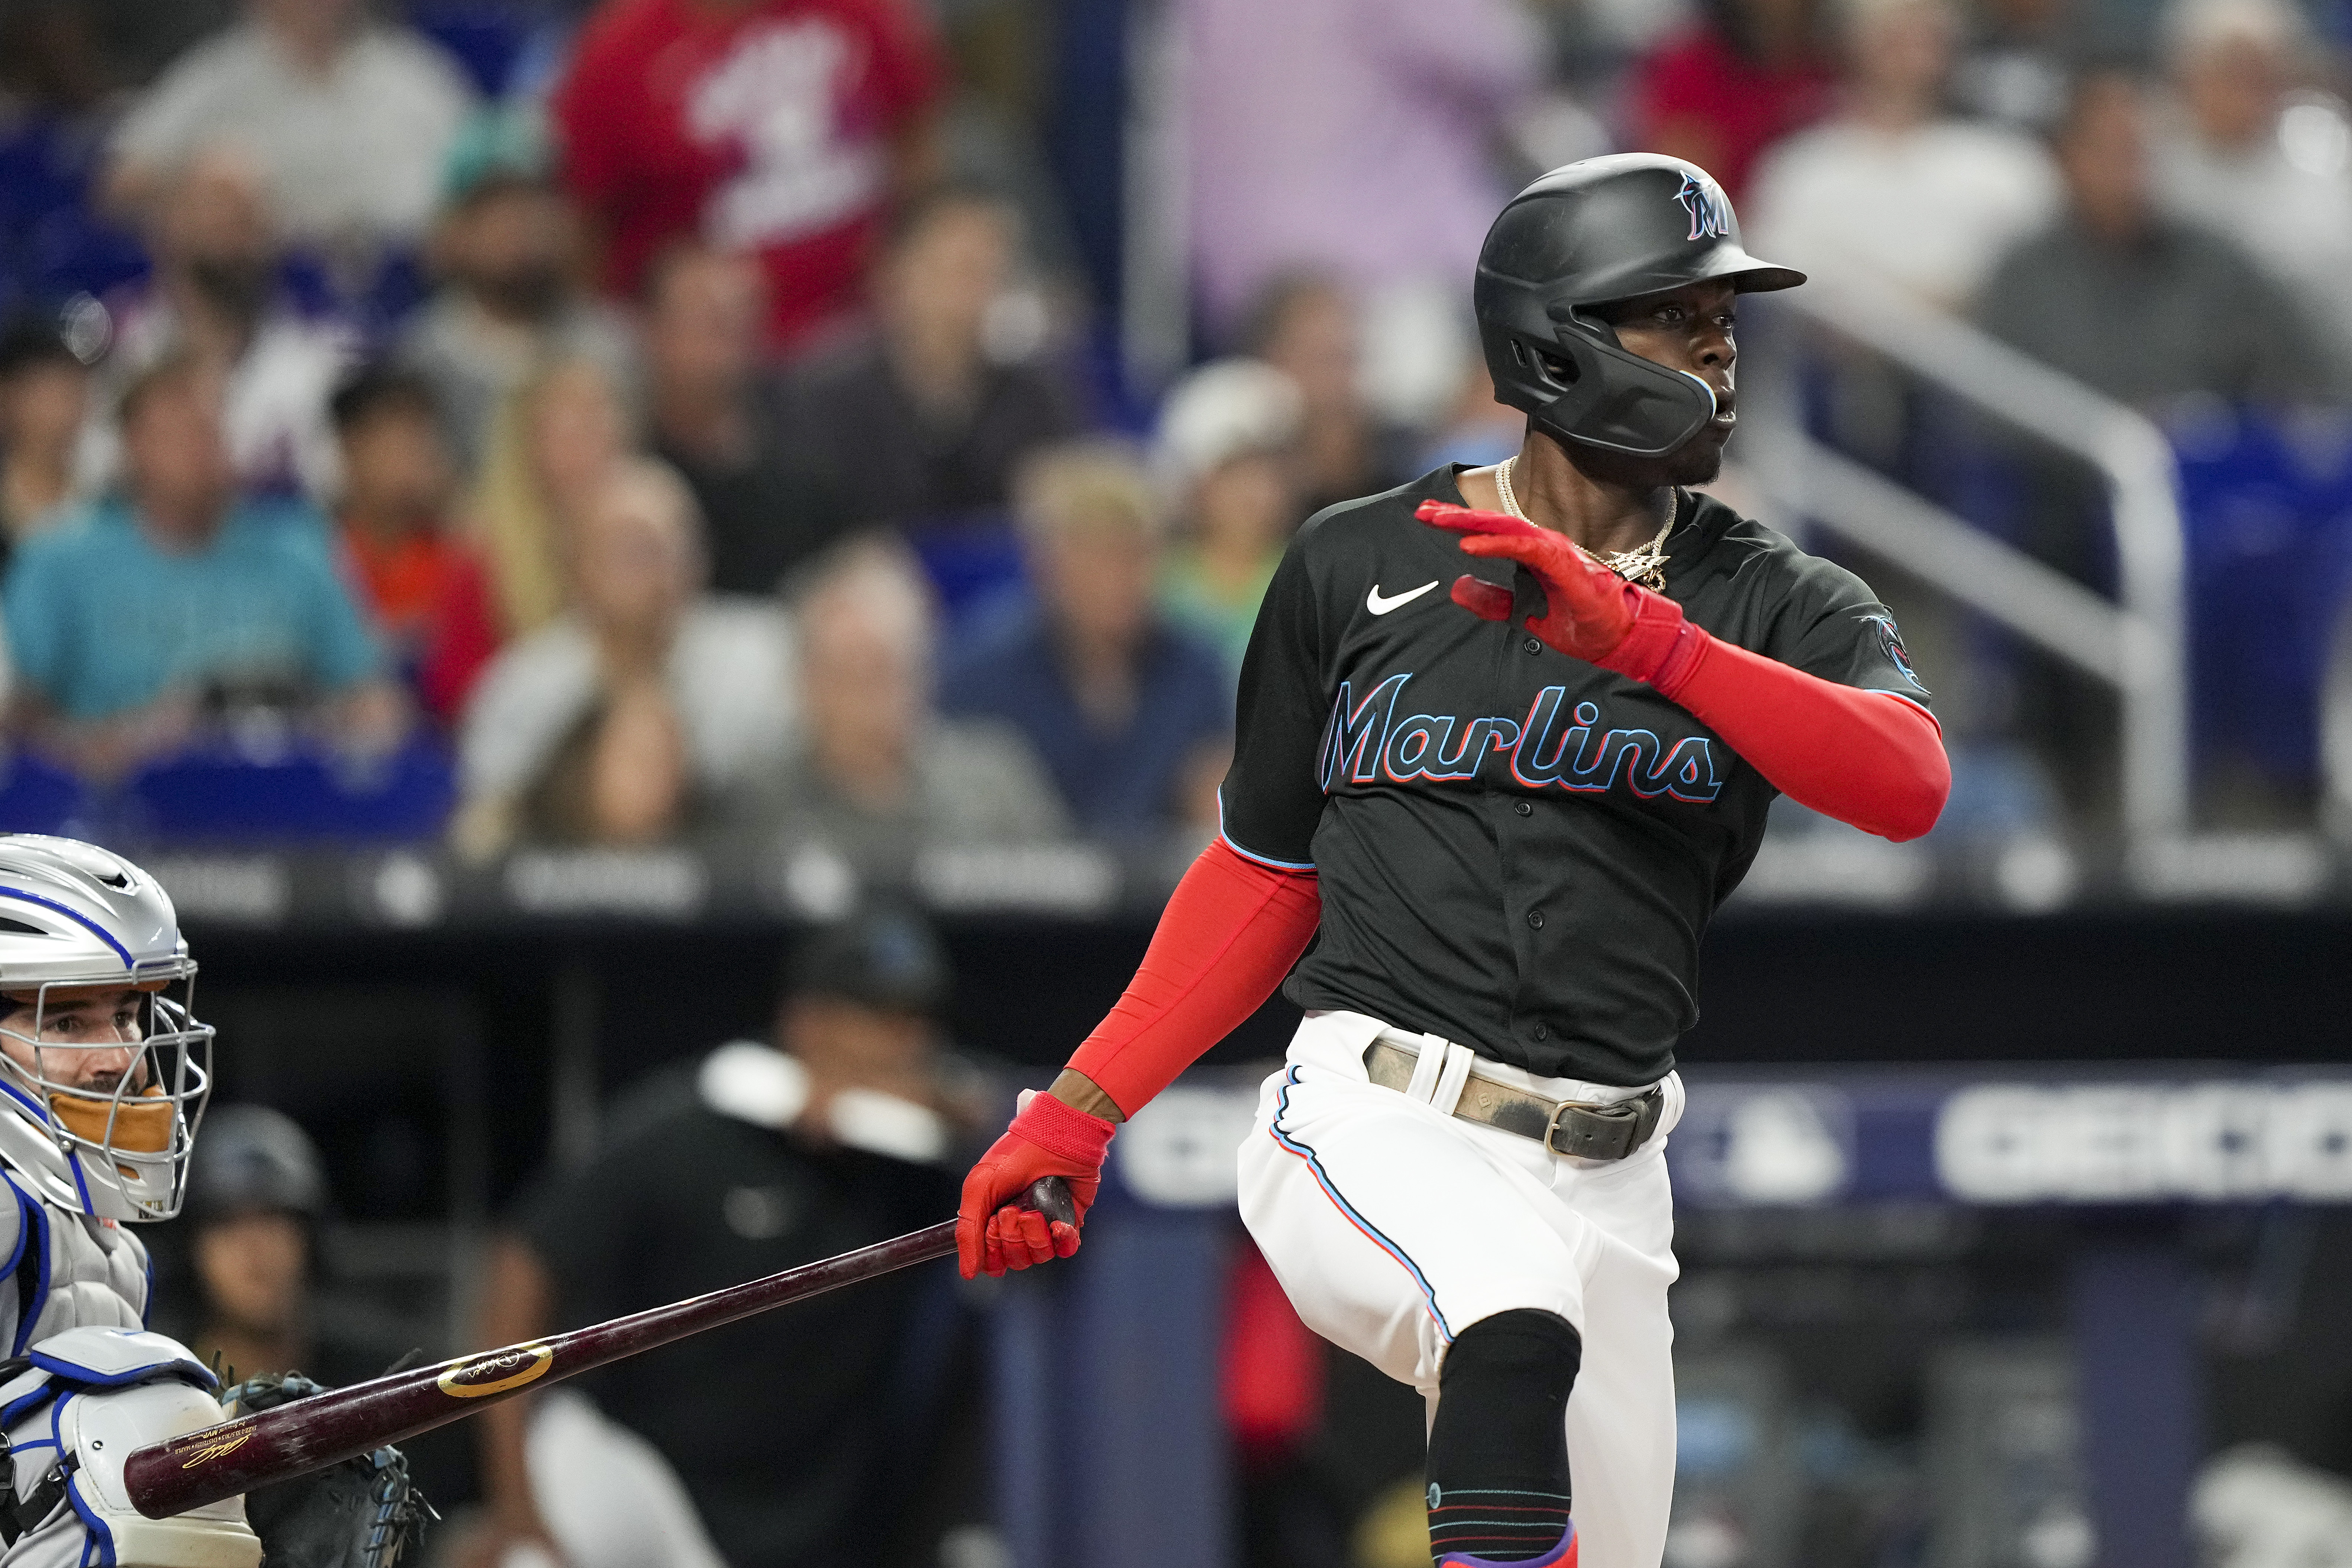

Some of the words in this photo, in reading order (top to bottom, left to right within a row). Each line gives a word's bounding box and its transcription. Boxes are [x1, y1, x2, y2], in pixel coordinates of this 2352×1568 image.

[1322, 673, 1723, 803] Marlins
[203, 1430, 218, 1438] MVP
[175, 1446, 191, 1454] MAPLE
